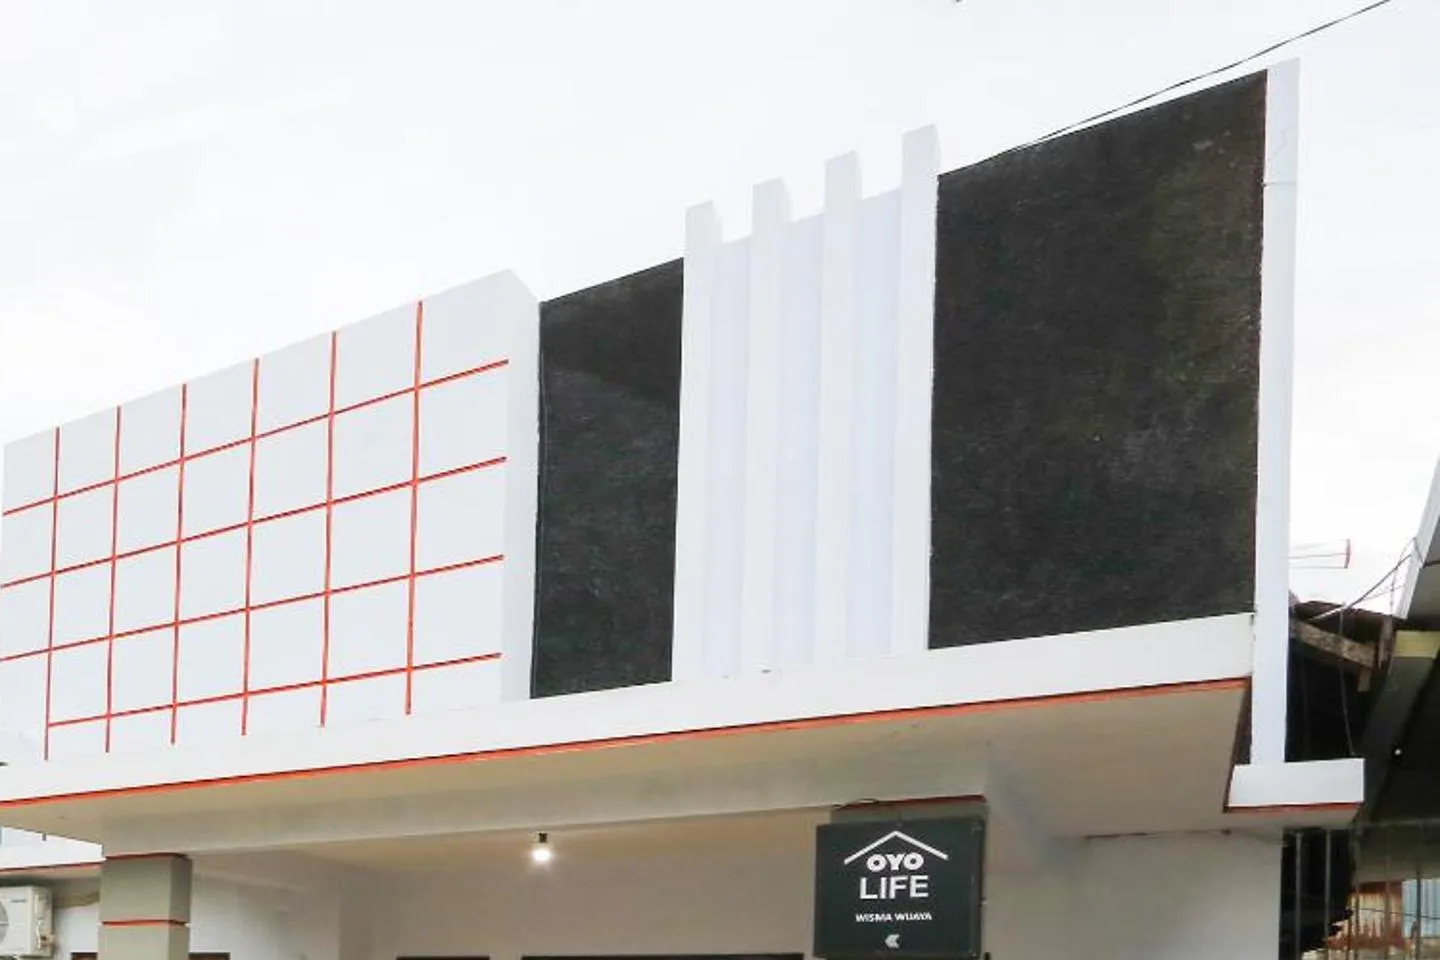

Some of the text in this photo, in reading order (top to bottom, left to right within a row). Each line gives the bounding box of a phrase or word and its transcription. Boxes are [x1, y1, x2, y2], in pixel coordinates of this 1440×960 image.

[866, 852, 925, 872] OYO
[859, 874, 930, 900] LIFE
[855, 912, 893, 923] WISMA
